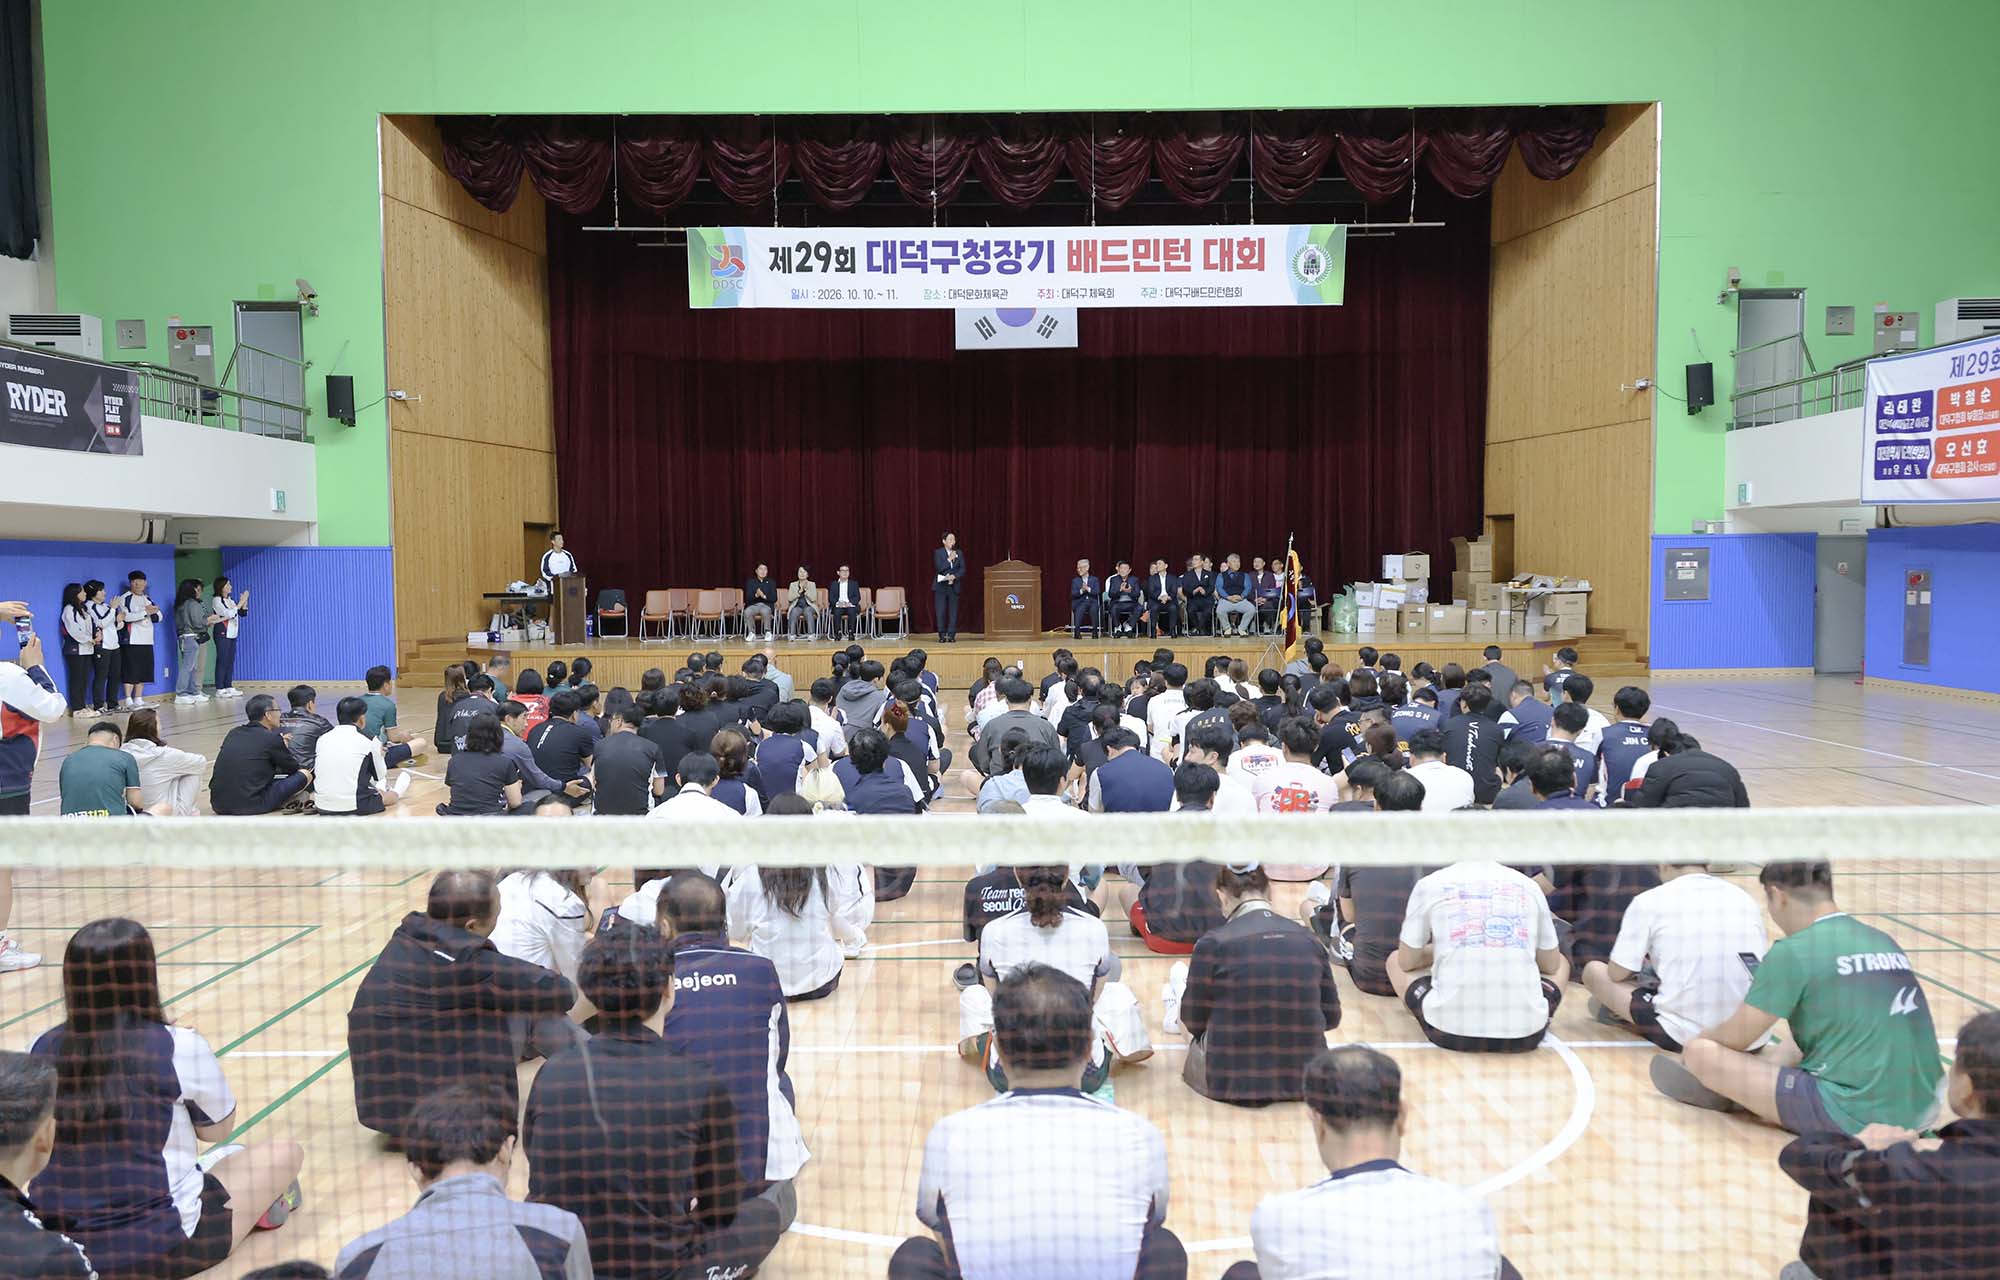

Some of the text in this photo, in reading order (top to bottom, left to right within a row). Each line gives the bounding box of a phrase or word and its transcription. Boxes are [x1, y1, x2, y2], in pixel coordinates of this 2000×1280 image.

[768, 236, 1266, 276] 제29회 대덕구청장기 배드민턴 대회
[712, 279, 744, 290] DDSC
[791, 289, 809, 301] 일시
[923, 288, 942, 301] 장소
[948, 288, 1009, 301] 대덕문화체육관
[1036, 288, 1054, 300] 주최
[1140, 287, 1158, 299] 주관
[1164, 286, 1243, 300] 대덕구배드민턴협회
[6, 382, 68, 417] RYDER
[981, 885, 1008, 900] Team
[982, 898, 1013, 913] seoul
[673, 970, 738, 992] aejeon
